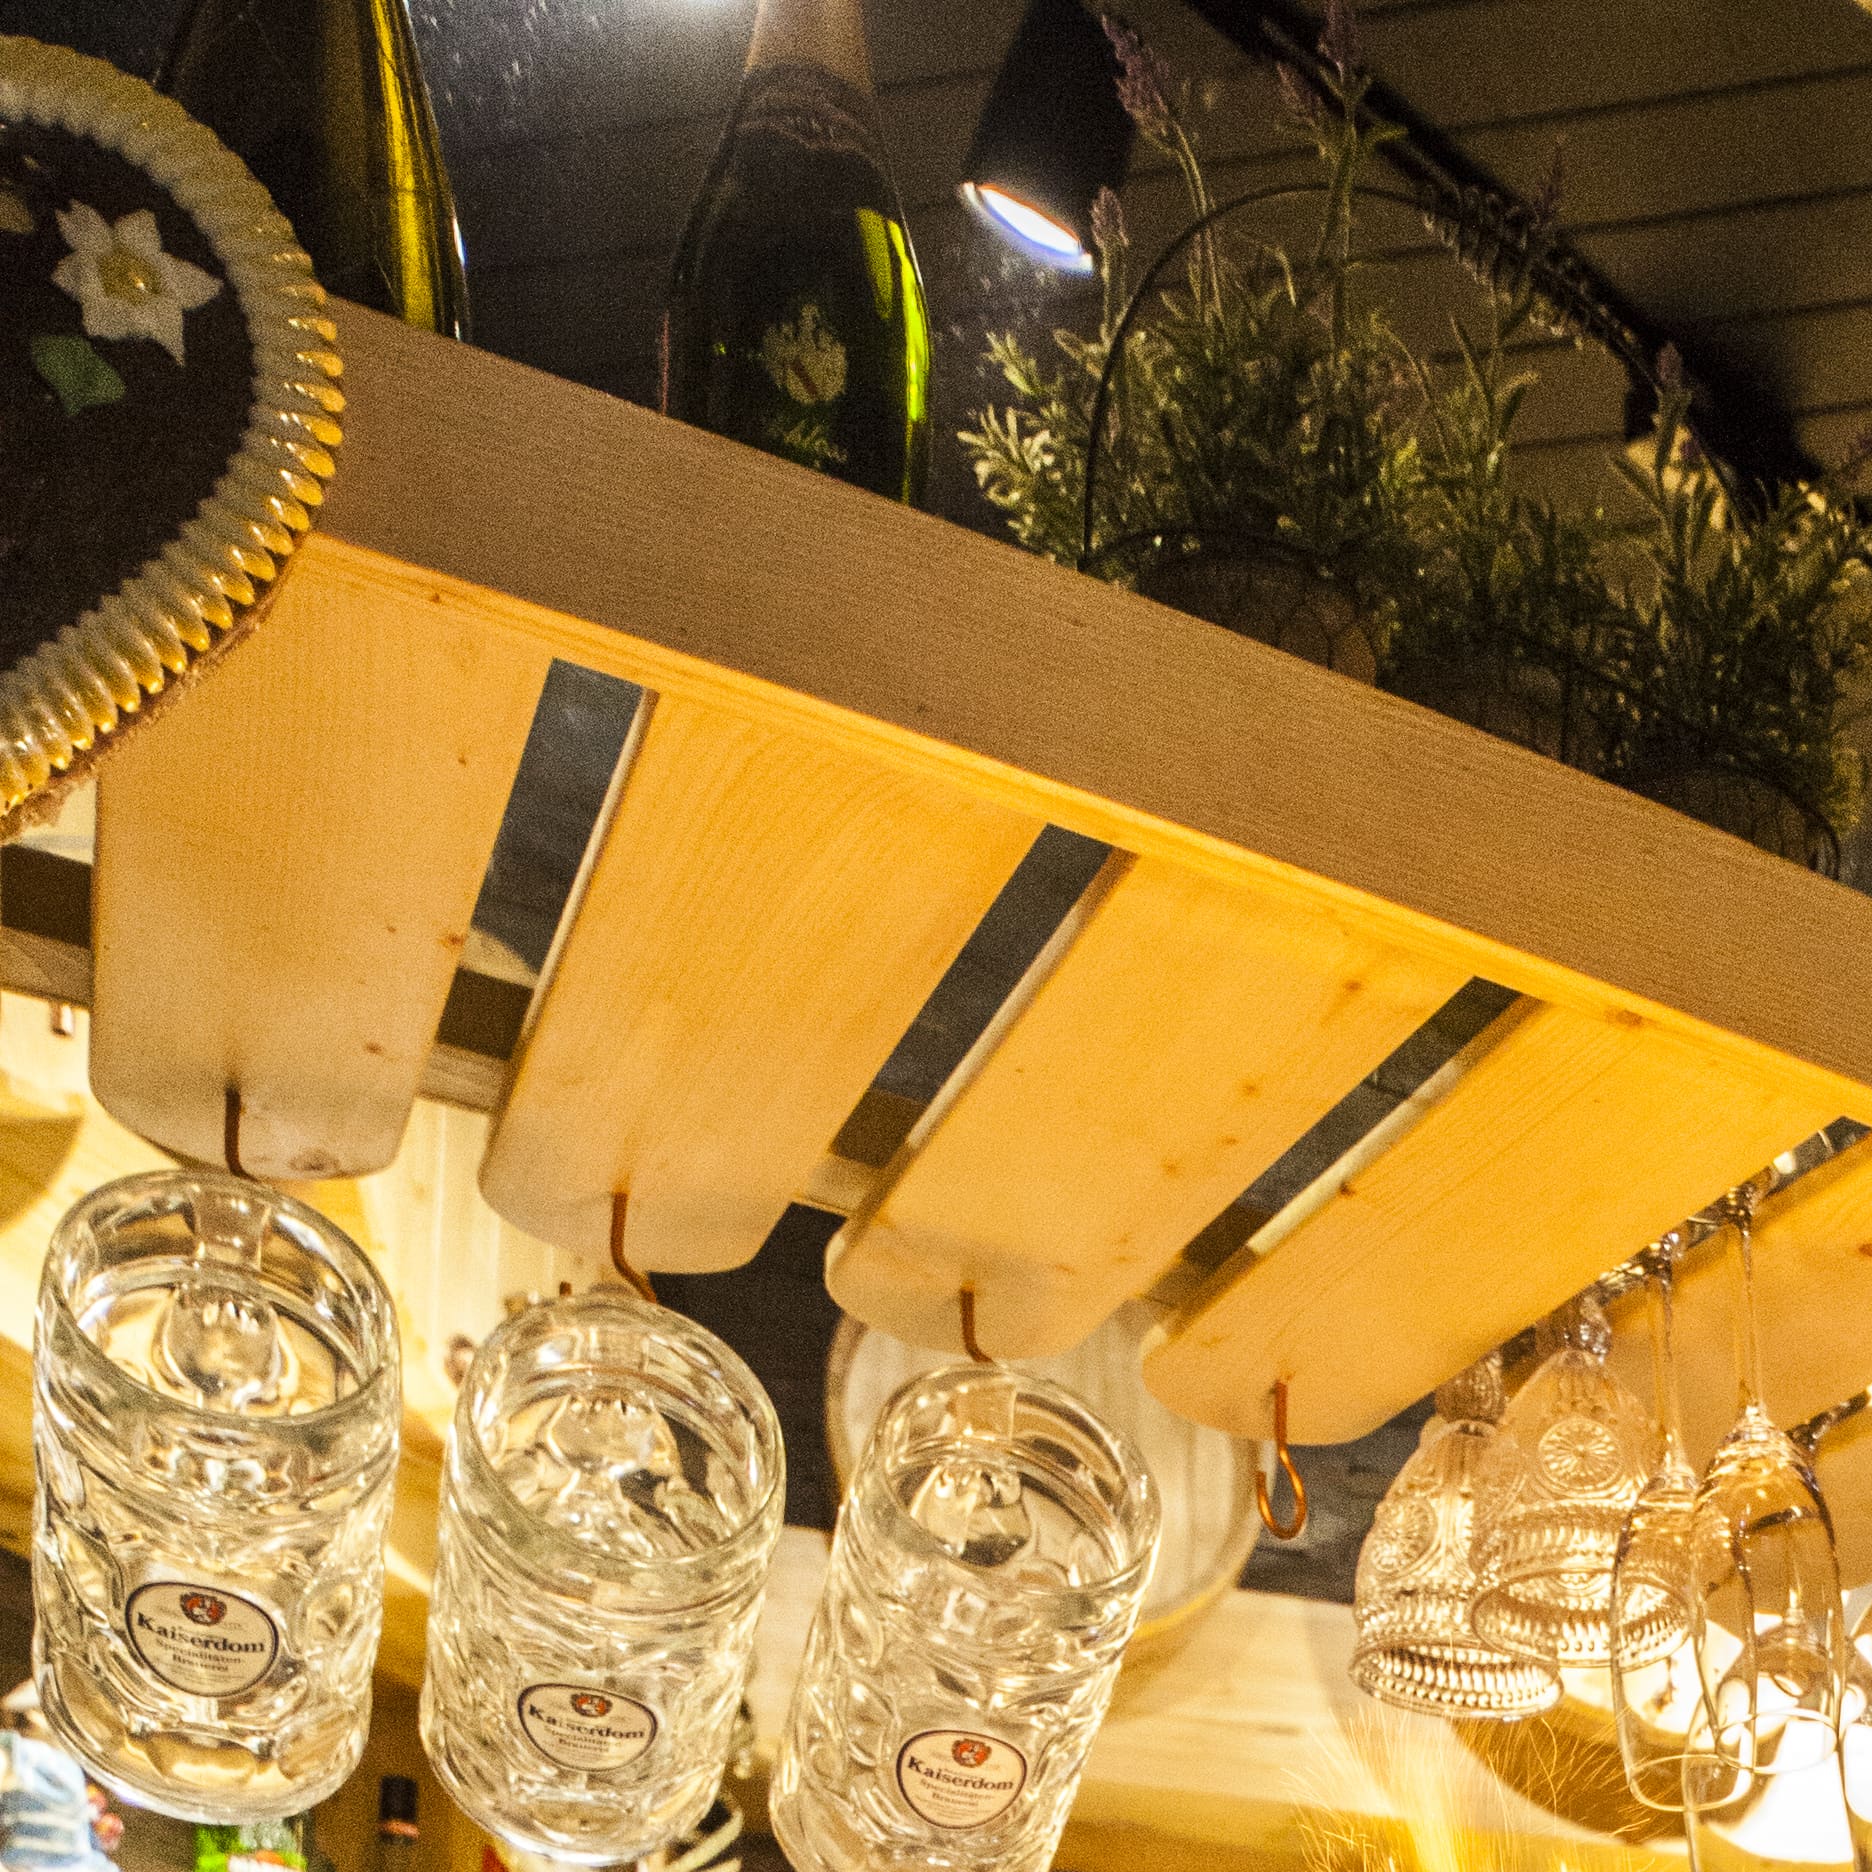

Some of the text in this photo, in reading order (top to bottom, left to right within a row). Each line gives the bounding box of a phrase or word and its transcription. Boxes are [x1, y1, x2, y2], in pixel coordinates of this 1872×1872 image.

[137, 1611, 265, 1653] Kaiserdom
[528, 1703, 645, 1740] Kaiserdom
[907, 1755, 1015, 1791] Kaiserdom
